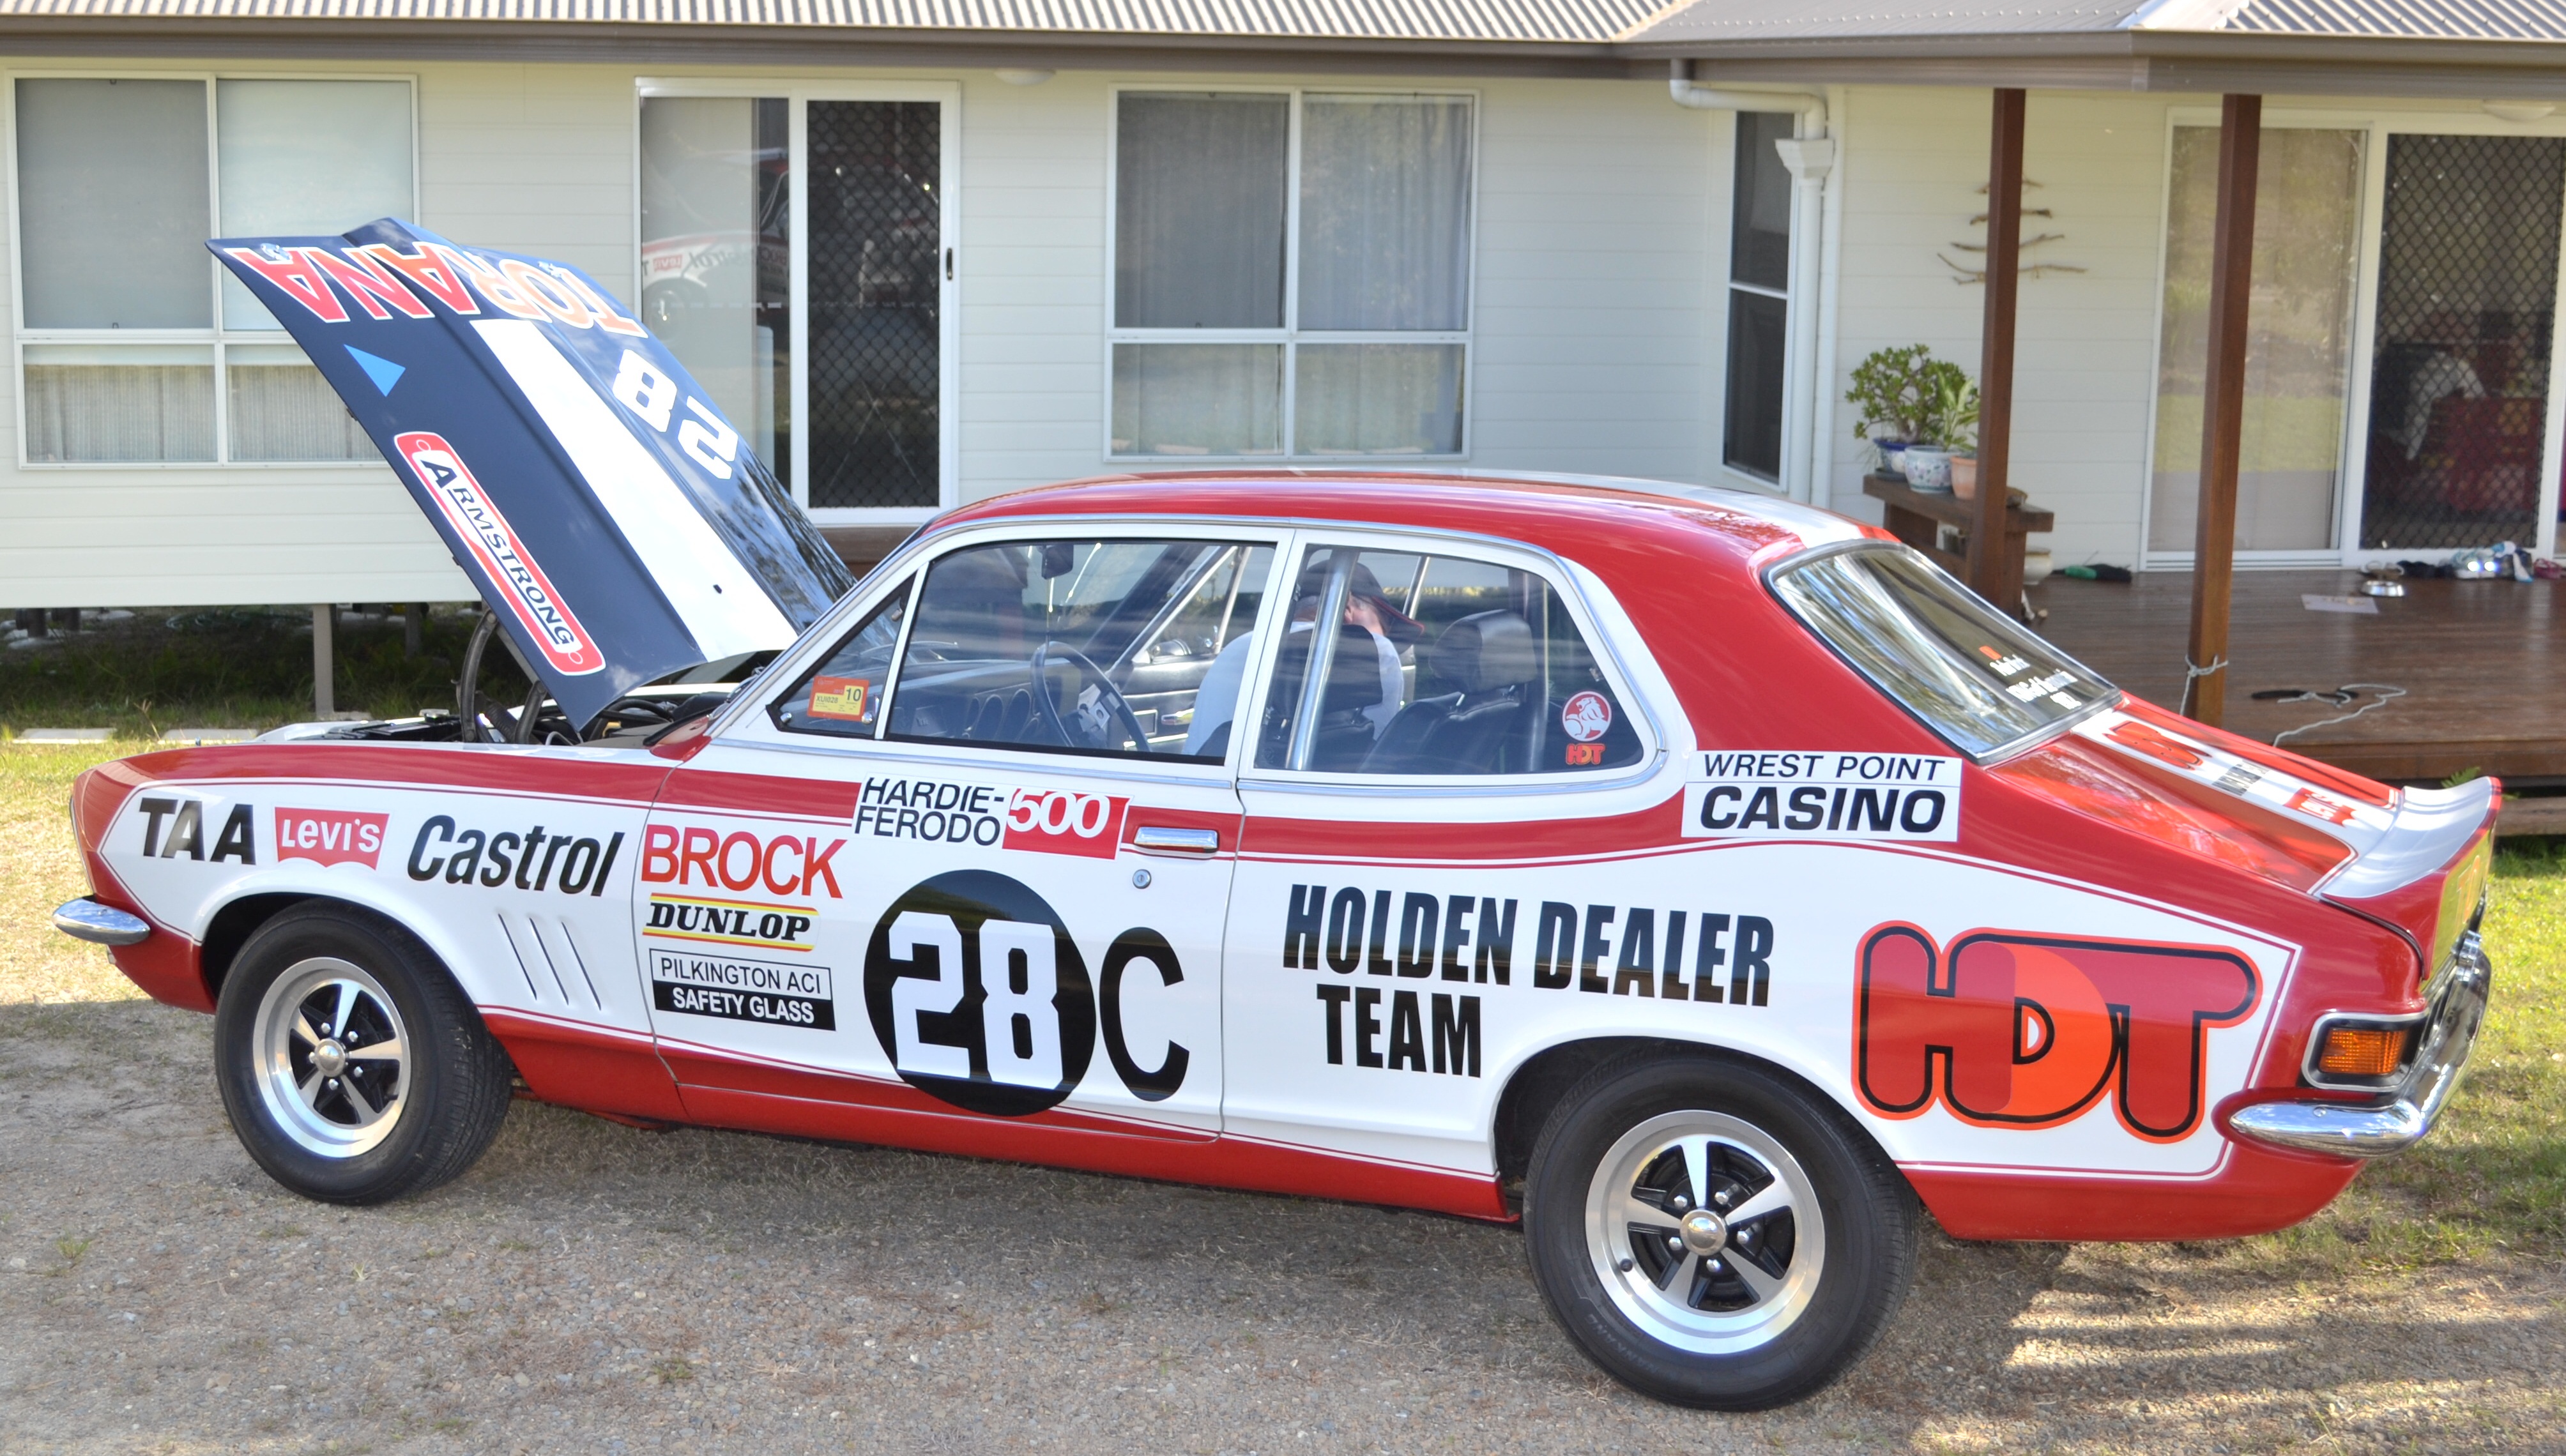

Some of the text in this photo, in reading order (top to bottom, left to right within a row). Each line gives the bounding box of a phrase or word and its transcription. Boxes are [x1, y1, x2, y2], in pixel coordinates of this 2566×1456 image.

[224, 241, 648, 338] TORANA
[613, 349, 738, 479] 28
[846, 687, 862, 702] 10
[1566, 743, 1606, 766] HDT
[1704, 754, 1946, 781] WREST POINT
[854, 788, 1111, 846] FERODO 500
[863, 777, 1005, 814] HARDIE-
[1700, 785, 1946, 833] CASINO
[139, 798, 256, 865] TAA
[407, 814, 625, 897] Castrol
[641, 823, 847, 899] BROCK
[646, 902, 811, 942] DUNLOP
[1283, 884, 1775, 1007] HOLDEN DEALER
[661, 957, 821, 994] PILKINGTON ACI
[673, 987, 814, 1024] SAFETY GLASS
[888, 911, 1190, 1102] 28 C
[1317, 983, 1481, 1078] TEAM
[1851, 920, 2263, 1144] HDT
